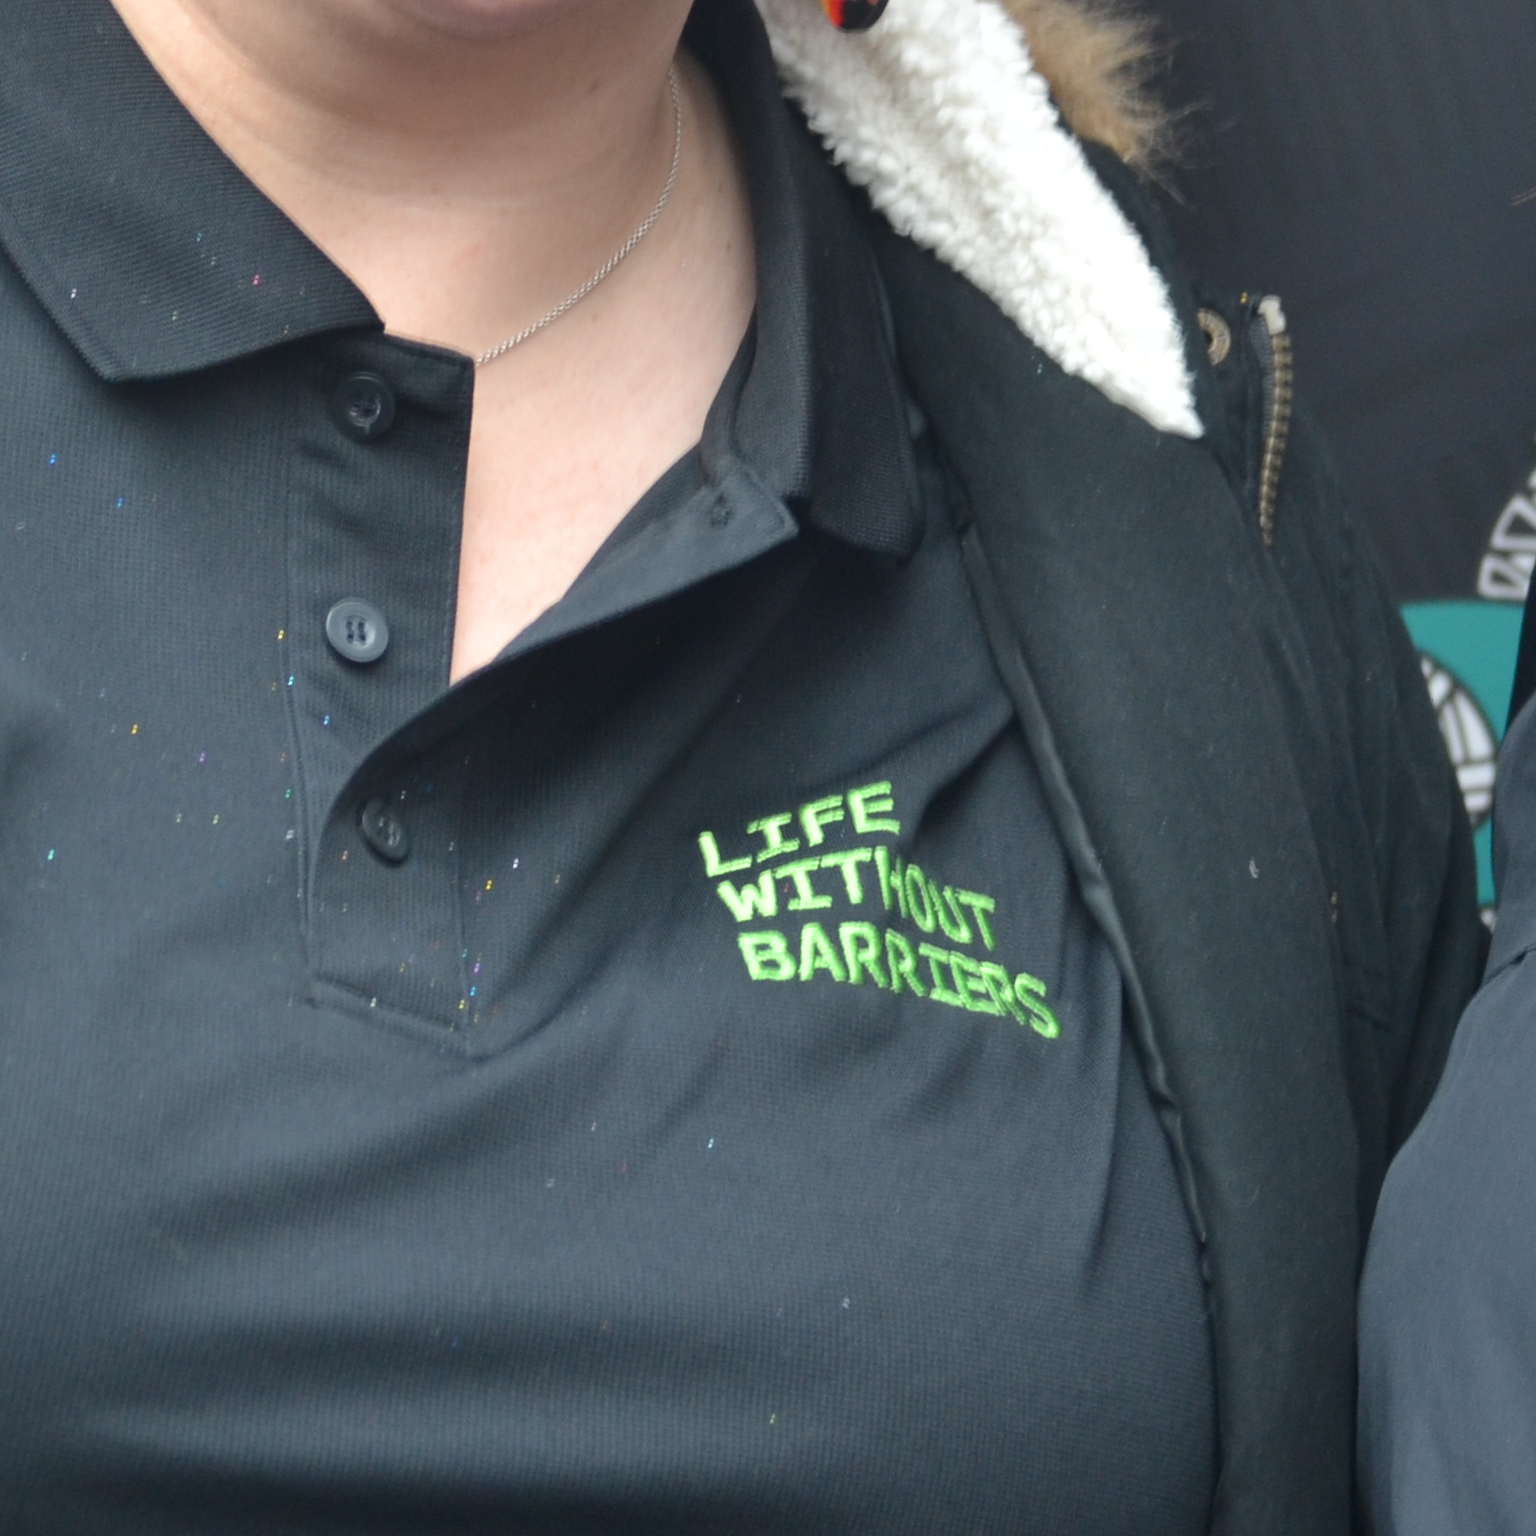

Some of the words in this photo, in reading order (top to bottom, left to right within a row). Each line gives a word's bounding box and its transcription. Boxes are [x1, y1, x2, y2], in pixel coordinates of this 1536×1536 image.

[697, 780, 901, 877] LIFE
[716, 845, 997, 952] WITHOUT
[737, 921, 1062, 1039] BARRIERS
